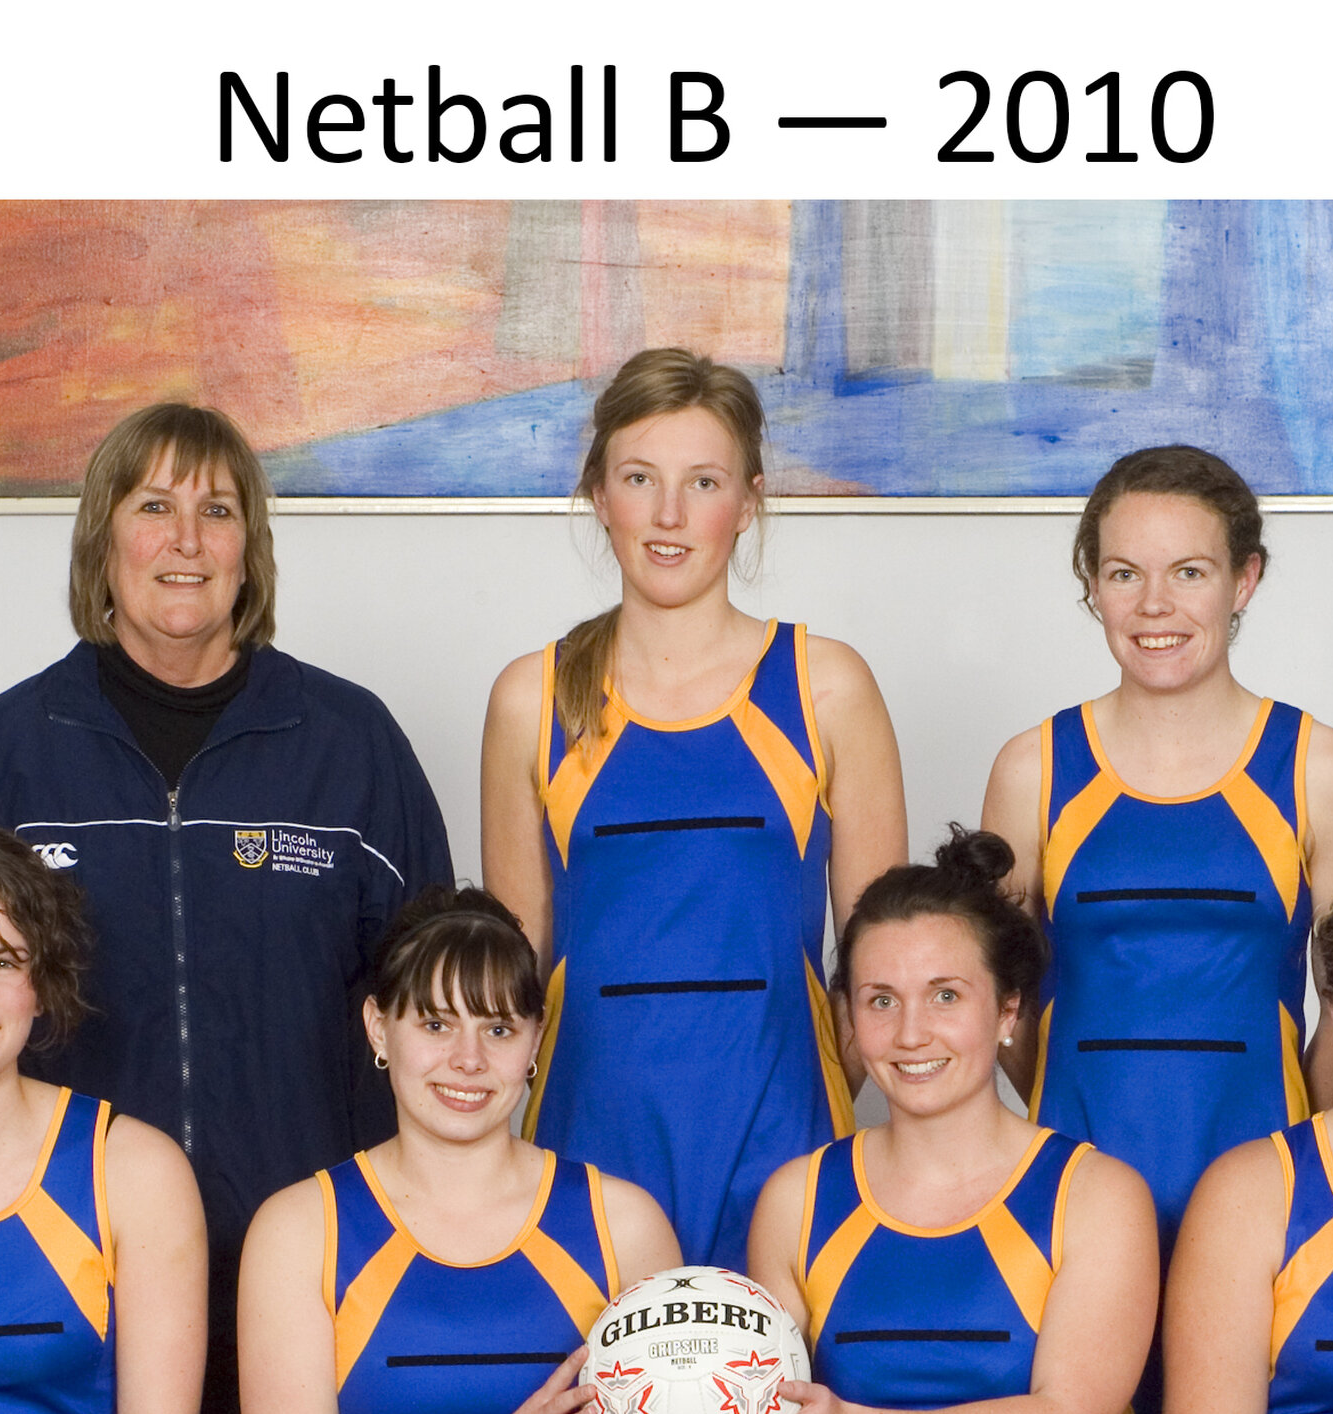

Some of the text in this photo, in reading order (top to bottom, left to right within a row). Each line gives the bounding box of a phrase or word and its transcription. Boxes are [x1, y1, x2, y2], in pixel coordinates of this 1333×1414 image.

[272, 829, 316, 847] Lincoln
[272, 841, 335, 864] University
[272, 862, 320, 876] NETBALL CLUB
[601, 1301, 772, 1348] GILBERT
[648, 1338, 719, 1359] GRIPSURE
